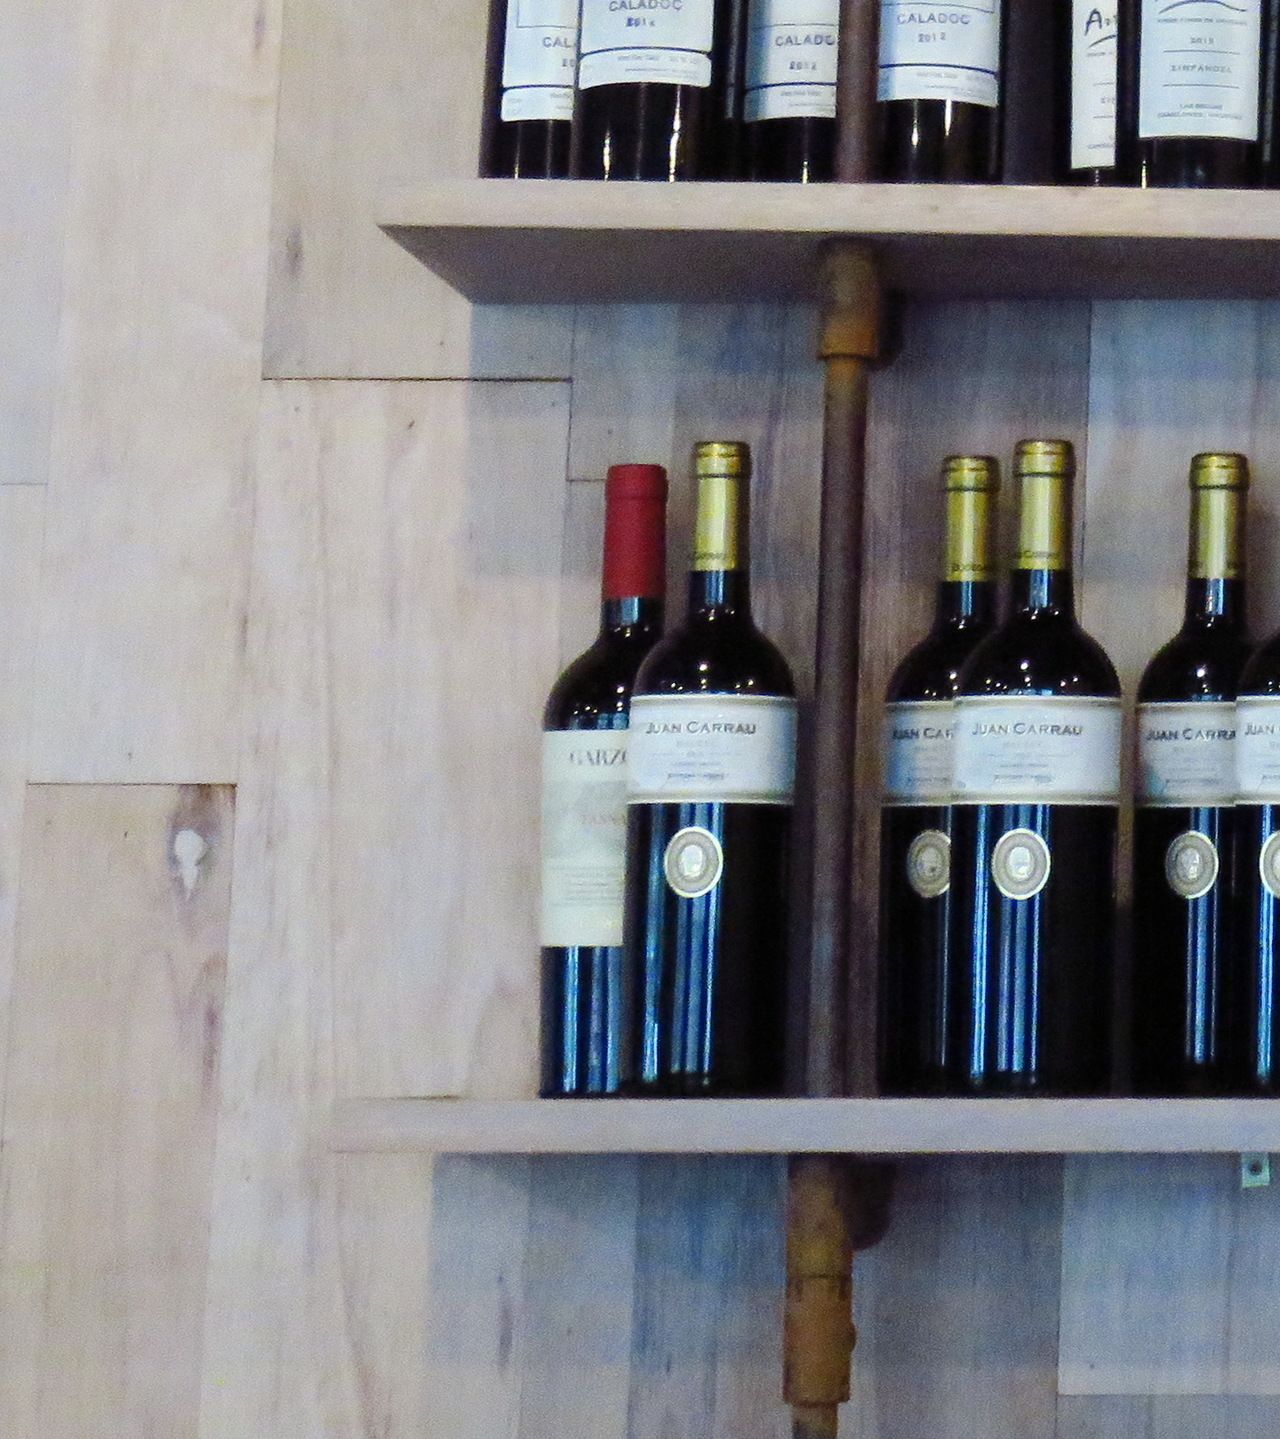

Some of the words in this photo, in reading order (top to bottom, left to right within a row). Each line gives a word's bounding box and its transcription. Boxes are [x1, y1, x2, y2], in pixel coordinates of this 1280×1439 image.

[896, 12, 971, 26] CALADOC
[775, 34, 836, 47] CALADO
[1170, 64, 1232, 73] ZINFANDEL
[645, 722, 682, 735] JUAN
[686, 721, 757, 736] CARRAU
[972, 722, 1009, 736] JUAN
[1013, 722, 1084, 736] CARRAU
[1182, 727, 1236, 741] CARRA
[1245, 722, 1275, 736] JUAN
